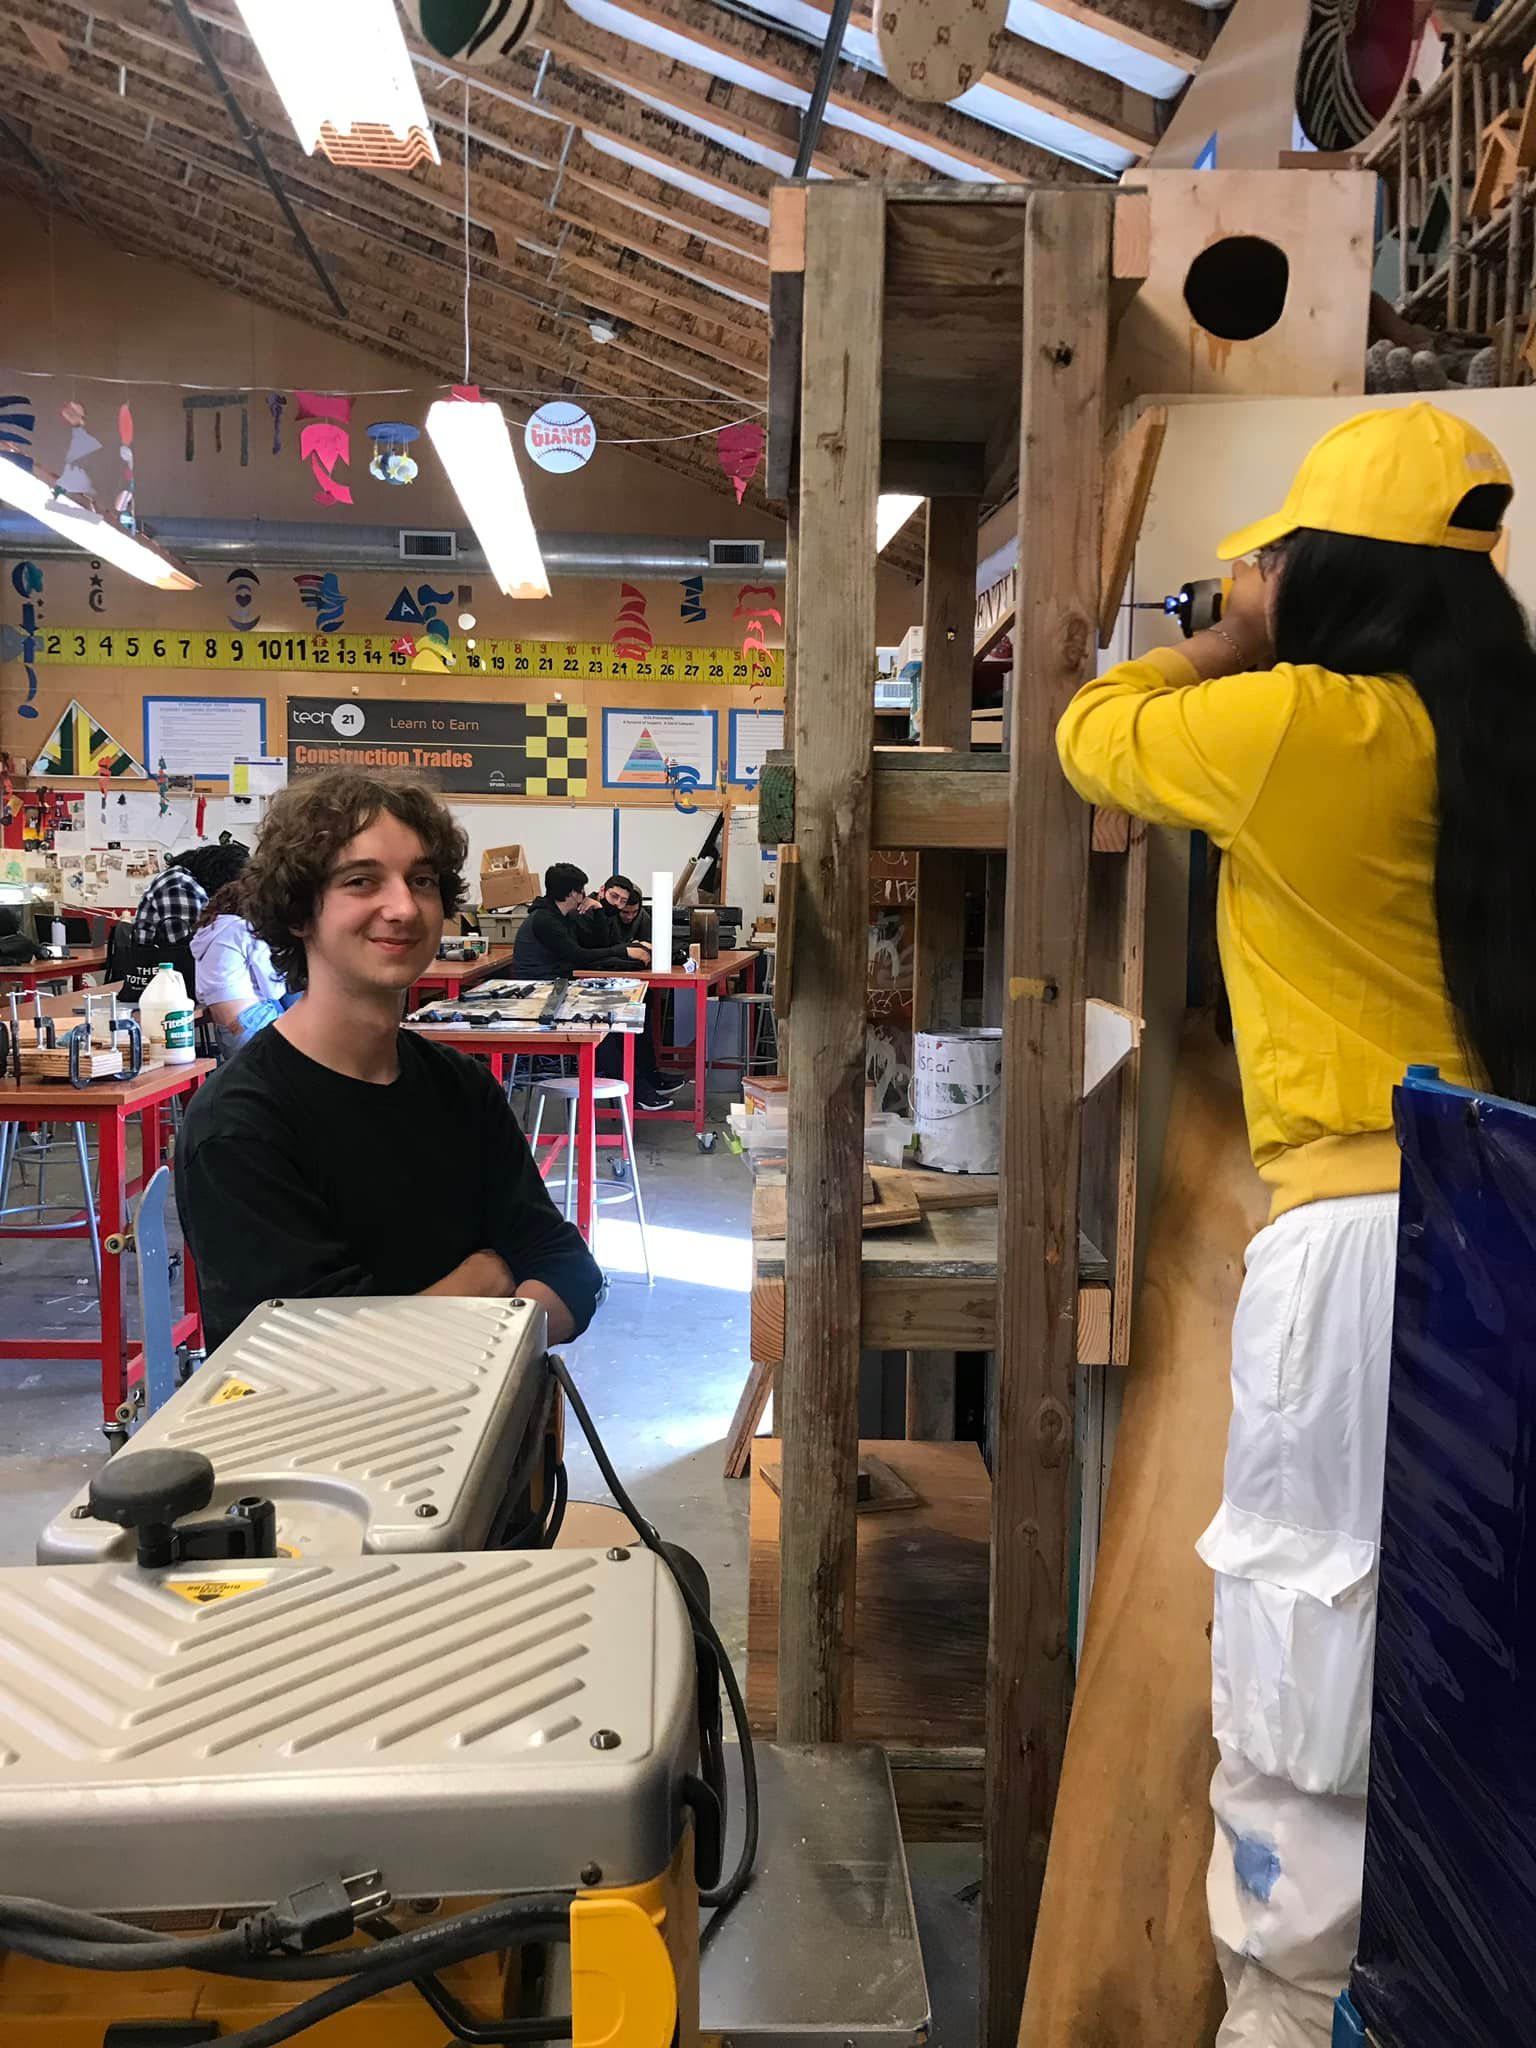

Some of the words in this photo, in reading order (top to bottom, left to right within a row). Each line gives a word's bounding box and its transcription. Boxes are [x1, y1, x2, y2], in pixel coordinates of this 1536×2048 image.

[531, 424, 591, 447] GIANTS
[514, 643, 522, 654] 8
[48, 636, 60, 654] 2
[74, 636, 85, 656] 3
[99, 636, 112, 656] 4
[126, 638, 139, 657] 5
[154, 640, 165, 657] 6
[179, 640, 190, 658] 7
[206, 639, 217, 658] 8
[231, 640, 243, 661] 9
[258, 640, 281, 659] 10
[285, 639, 306, 660] 11
[312, 650, 330, 663] 12
[337, 650, 356, 664] 13
[363, 651, 382, 664] 14
[389, 652, 406, 665] 15
[467, 655, 480, 668] 18
[491, 657, 504, 669] 19
[515, 658, 528, 669] 20
[539, 658, 553, 670] 21
[563, 660, 579, 671] 22
[589, 661, 602, 673] 23
[612, 663, 627, 674] 24
[637, 664, 652, 674] 25
[660, 664, 674, 675] 26
[684, 665, 699, 676] 27
[709, 665, 723, 677] 28
[733, 665, 747, 676] 29
[757, 666, 771, 677] 30
[342, 714, 354, 724] 21
[391, 718, 427, 729] Learn
[432, 720, 445, 729] to
[450, 719, 480, 731] Earn
[295, 745, 410, 766] Construction
[413, 749, 473, 768] Trades
[136, 967, 160, 975] THE
[126, 975, 148, 985] TOTE
